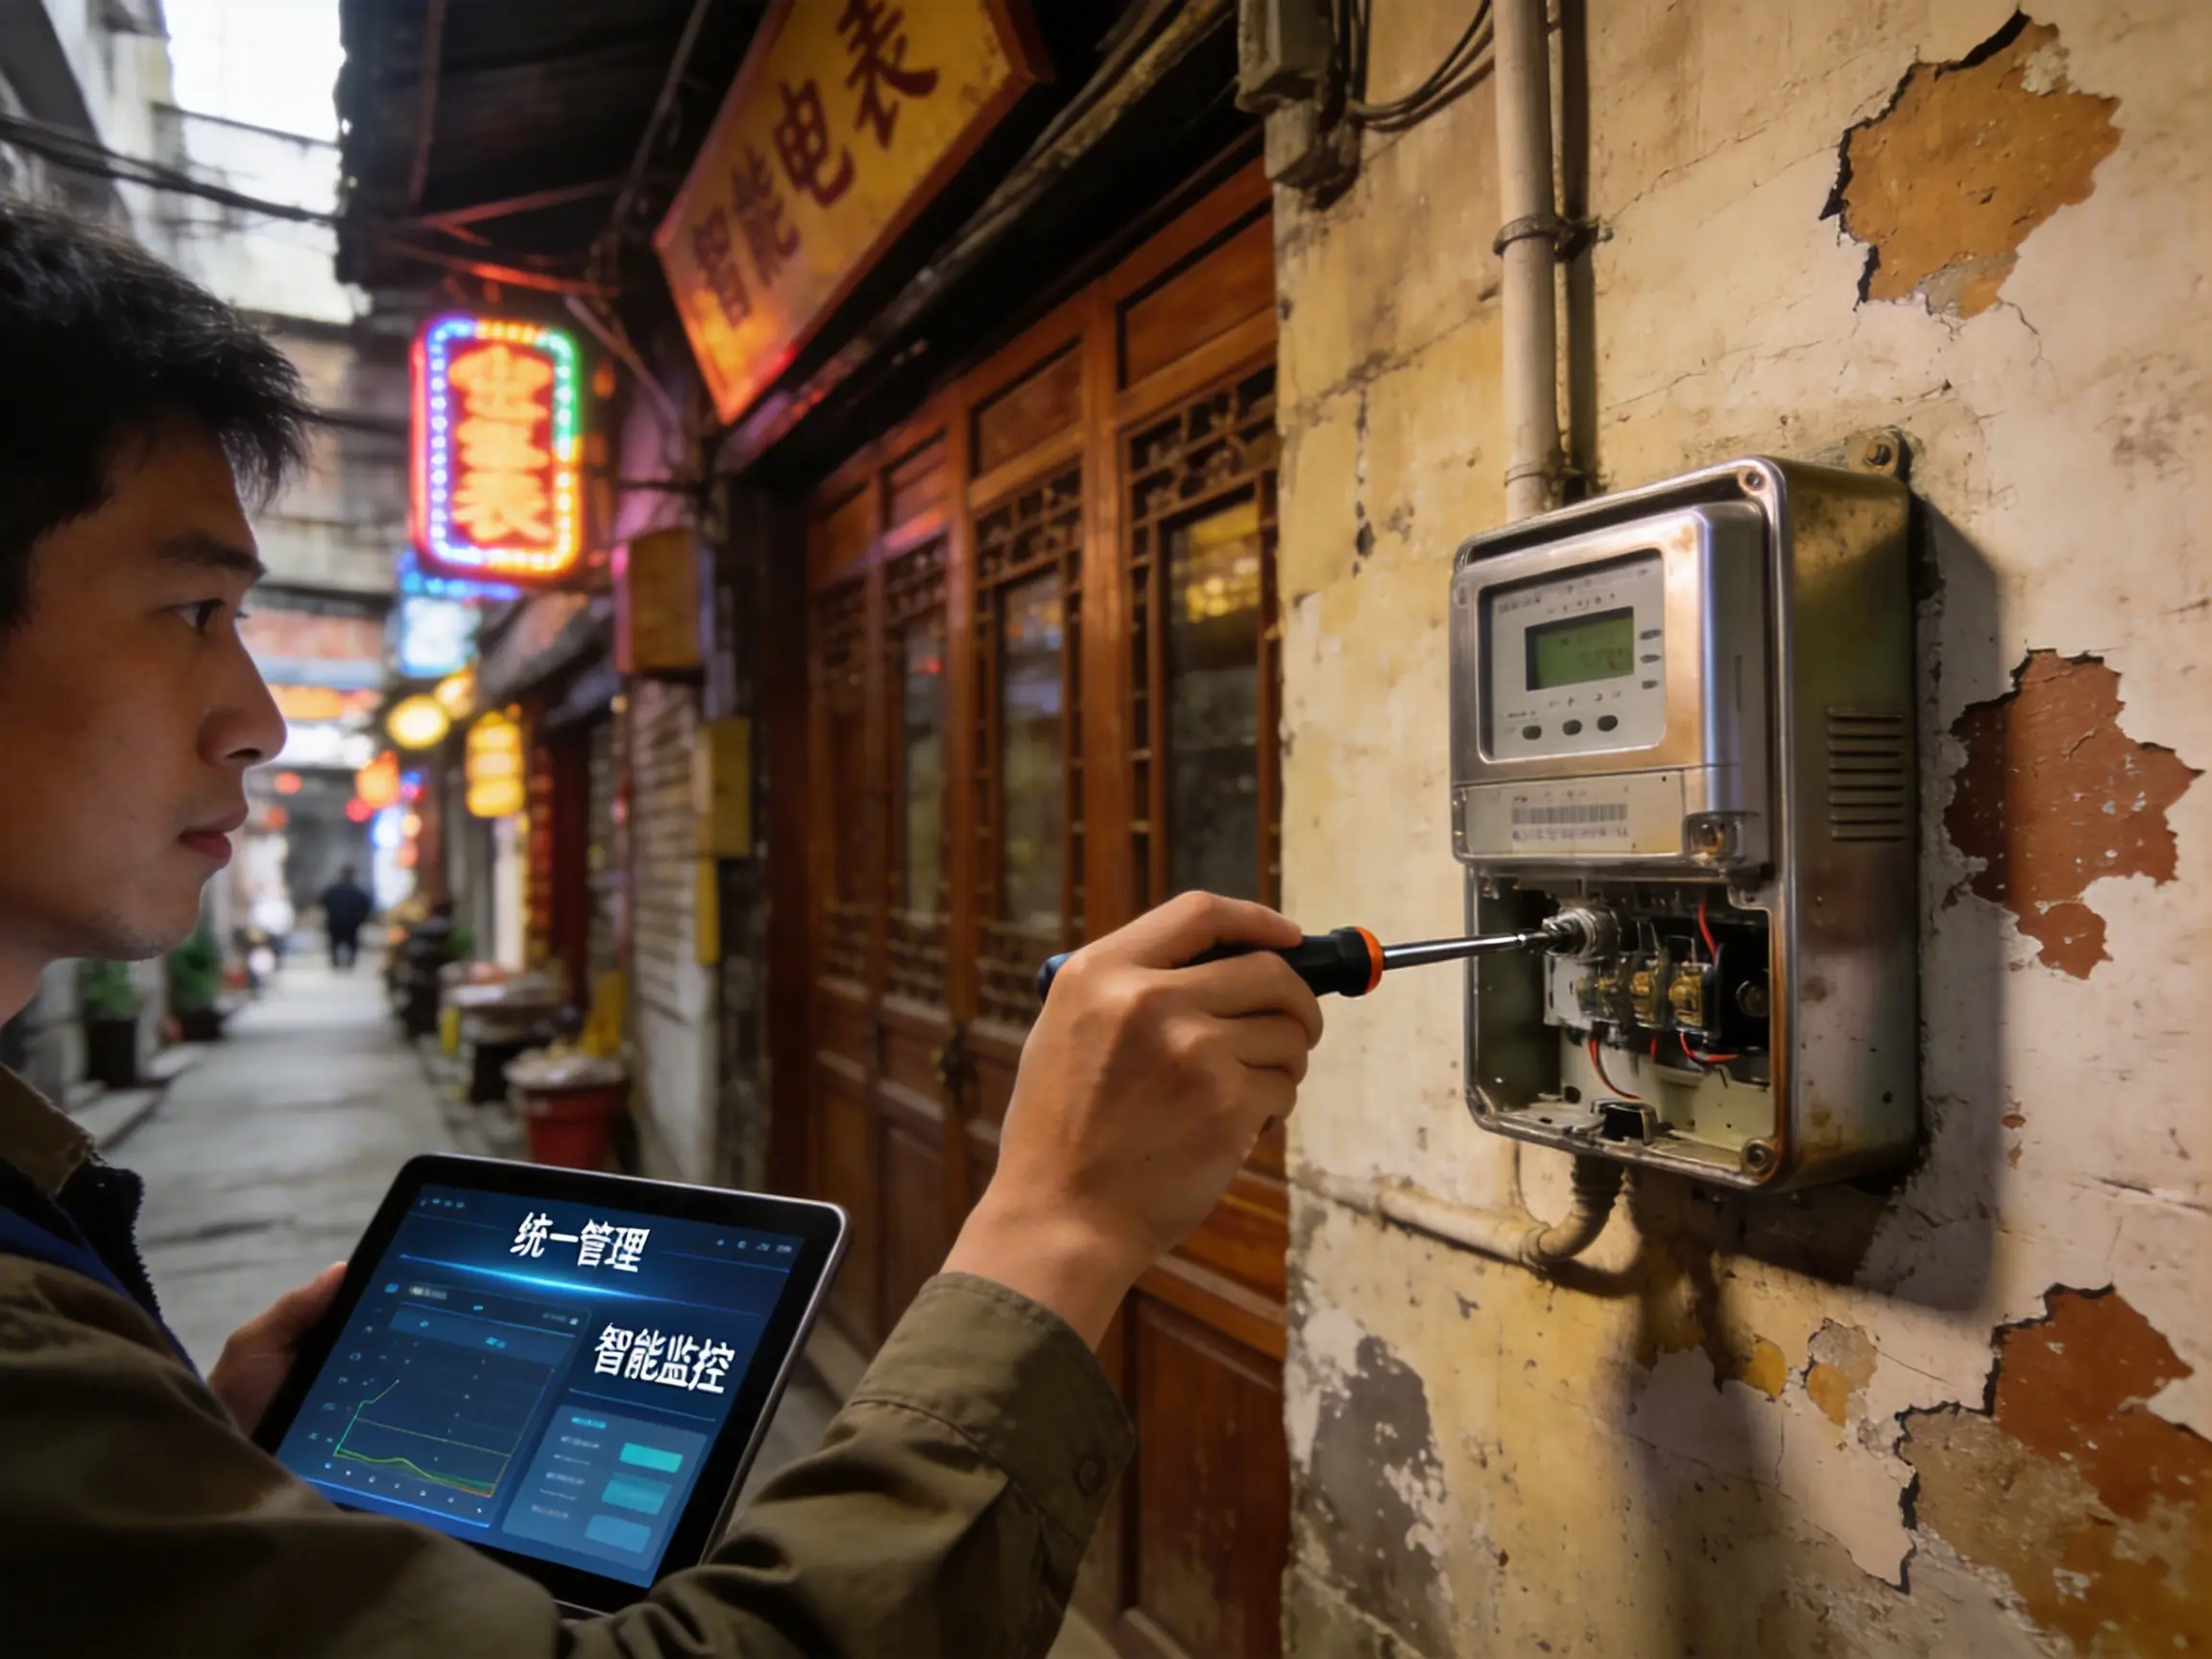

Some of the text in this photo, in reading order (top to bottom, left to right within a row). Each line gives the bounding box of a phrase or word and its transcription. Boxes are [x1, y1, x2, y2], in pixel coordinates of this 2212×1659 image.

[510, 1212, 650, 1273] 统一管理
[594, 1322, 735, 1394] 智能监控
